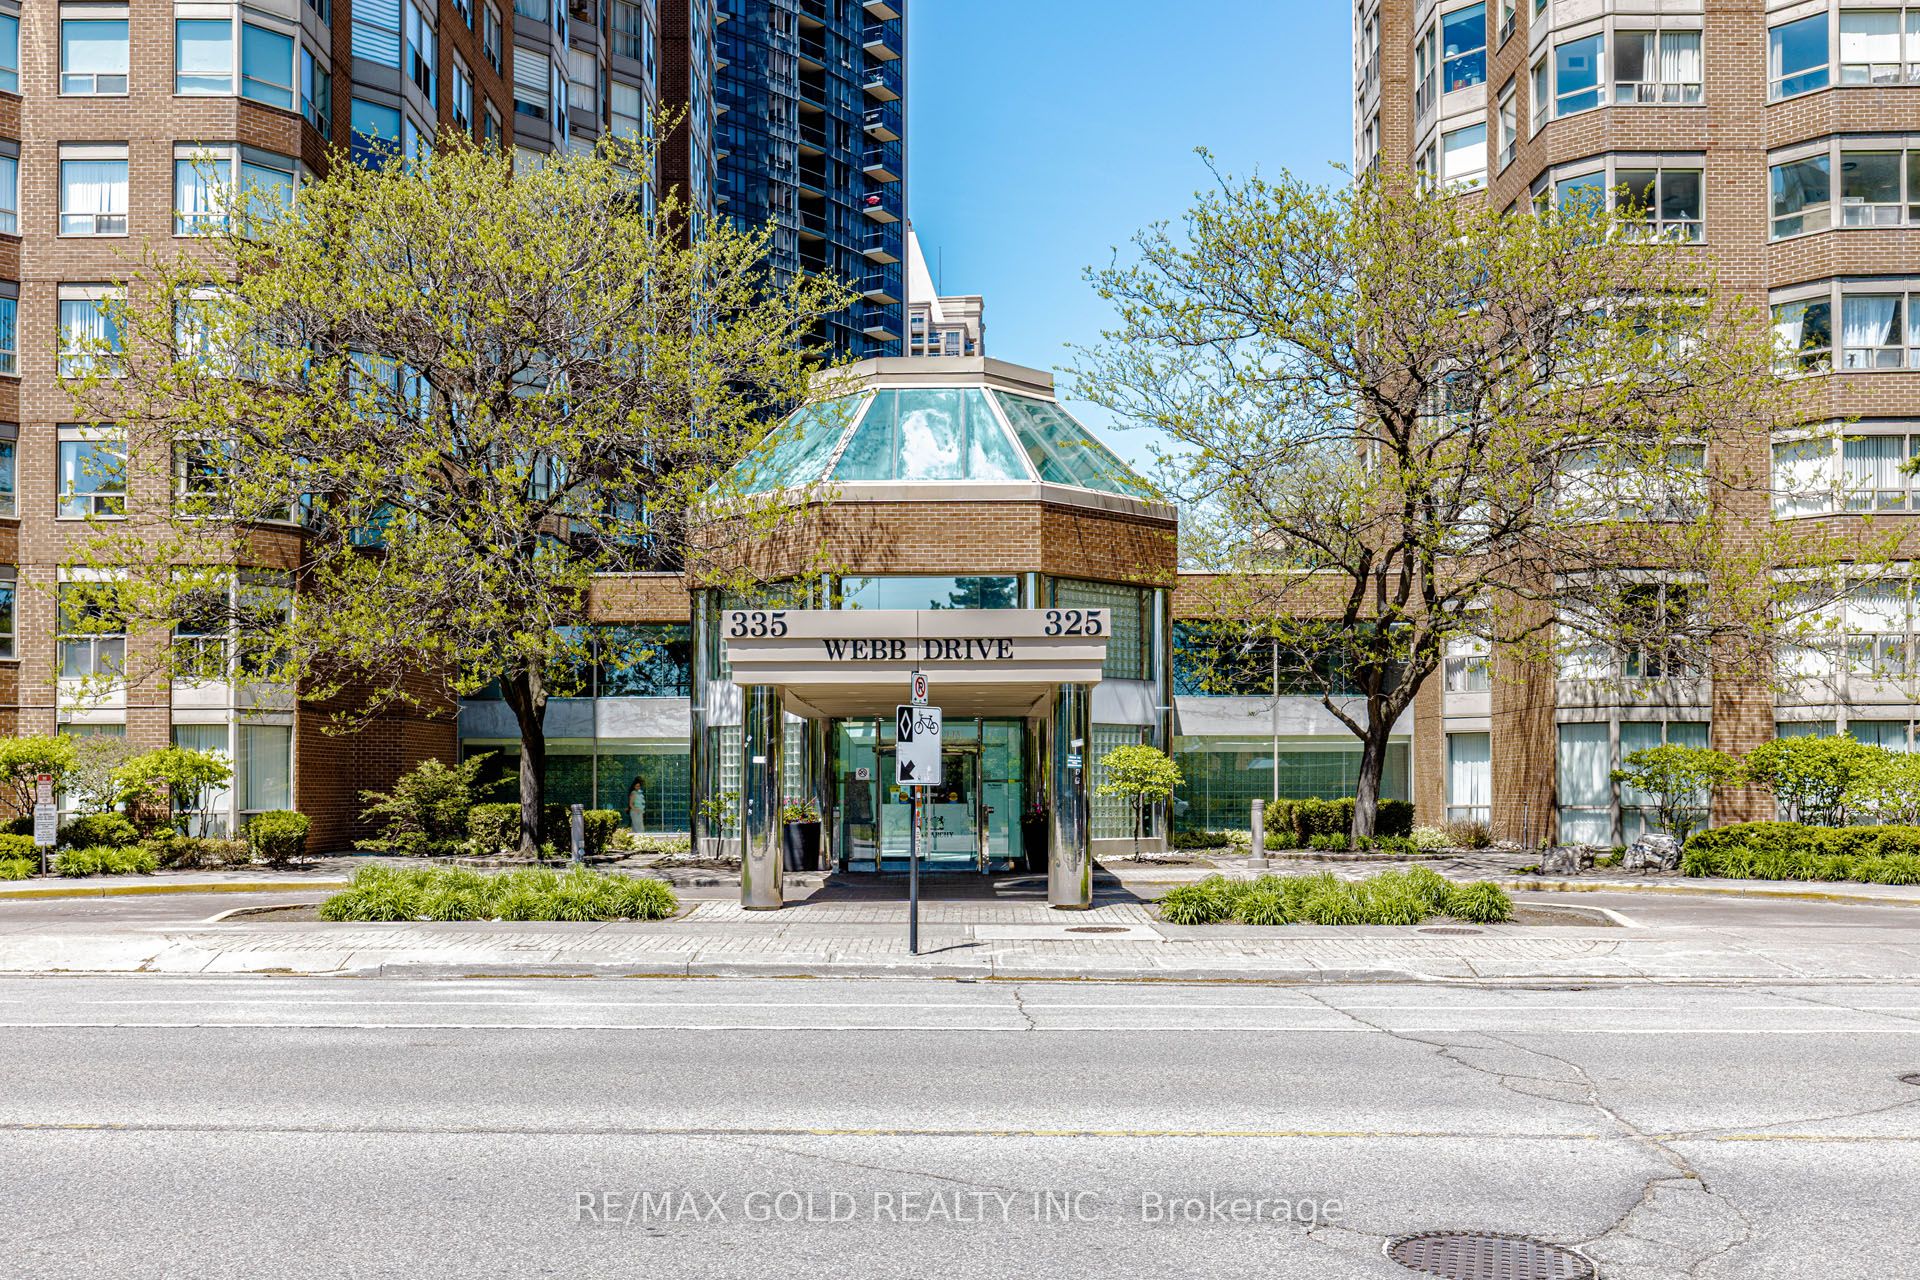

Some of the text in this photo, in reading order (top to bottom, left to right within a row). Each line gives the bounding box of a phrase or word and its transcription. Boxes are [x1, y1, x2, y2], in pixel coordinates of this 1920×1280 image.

[730, 611, 788, 637] 335
[1045, 610, 1102, 635] 325
[822, 638, 1013, 660] WEBB DRIVE
